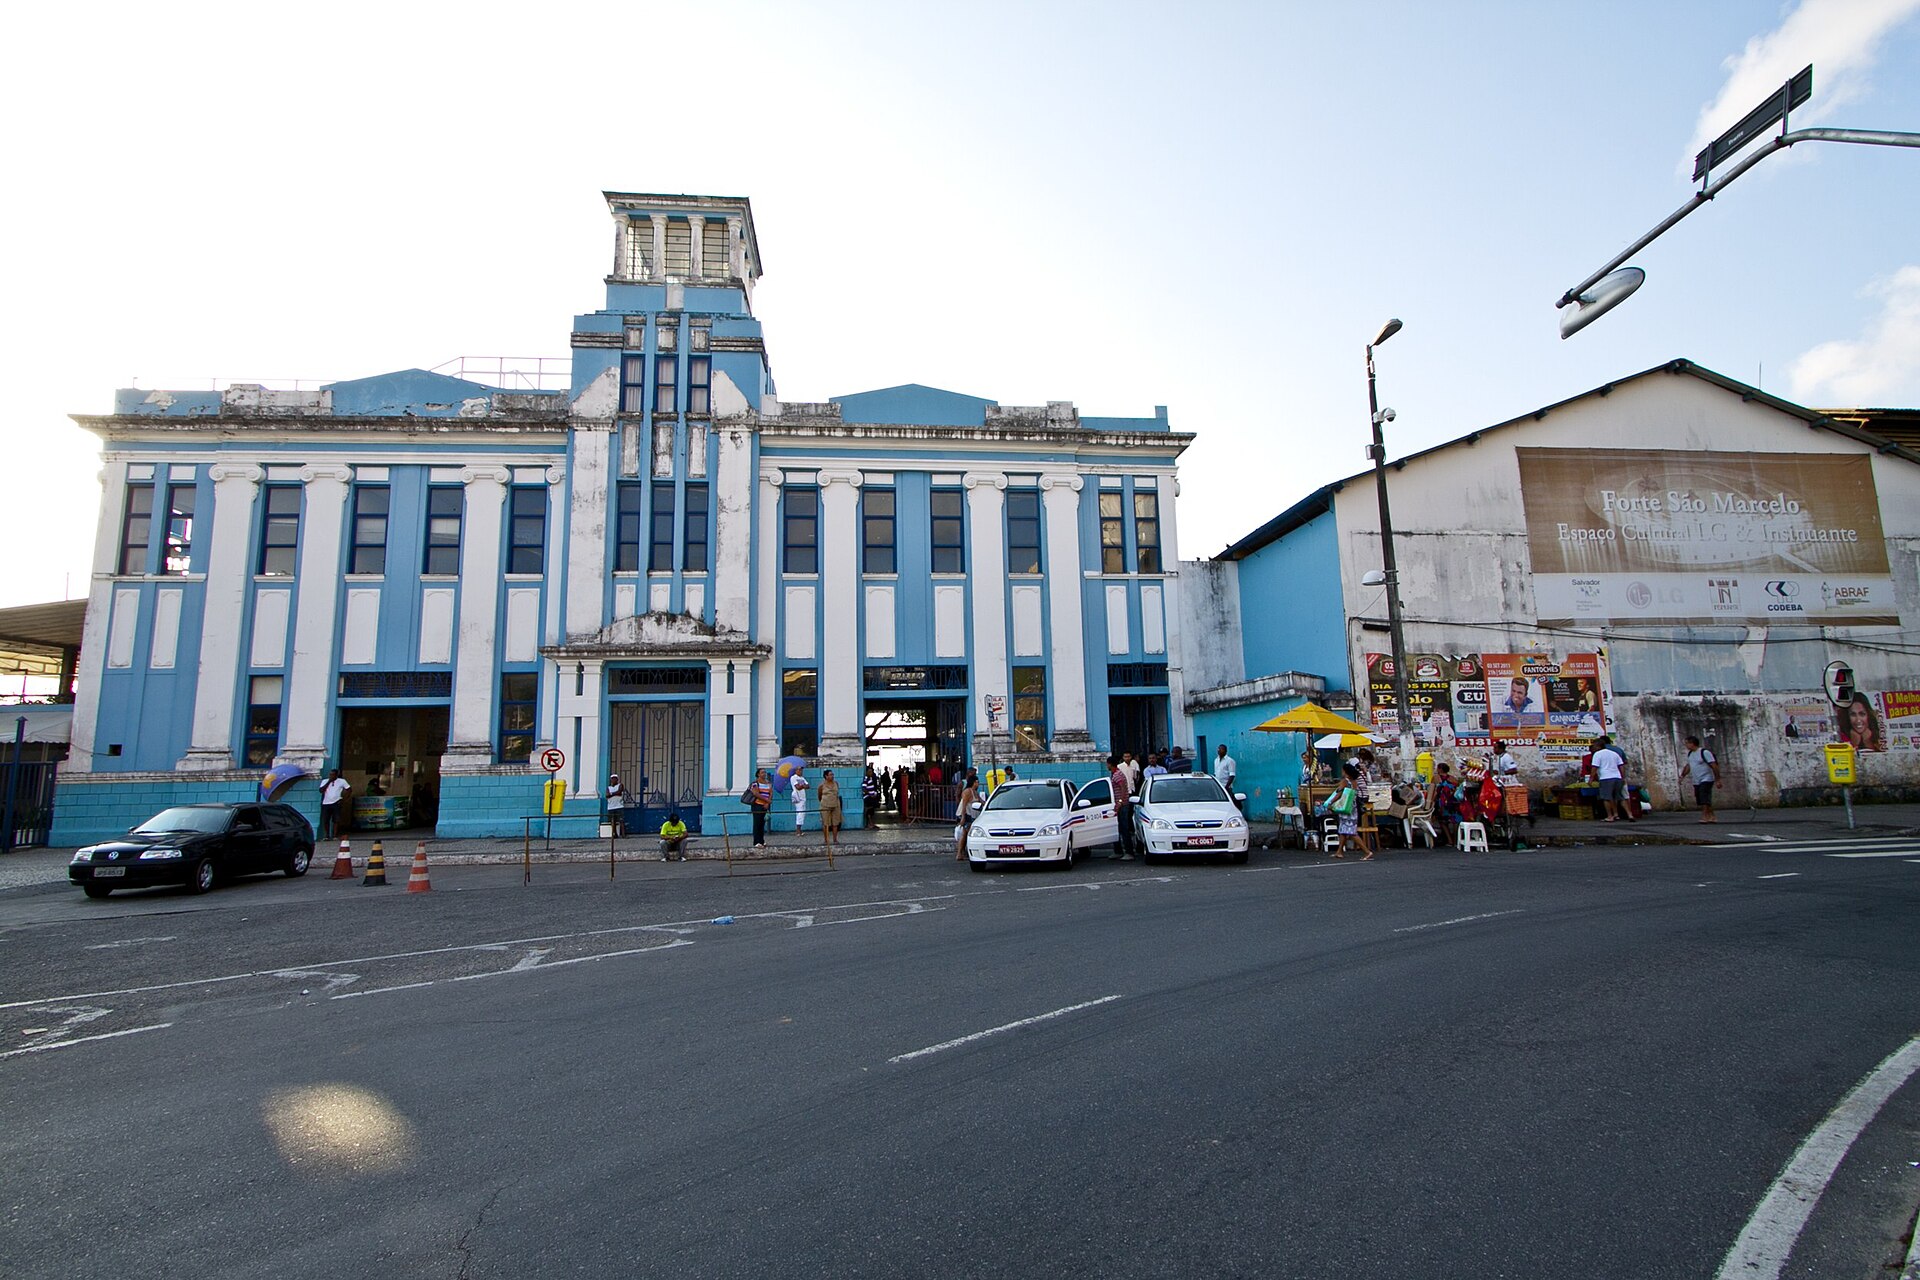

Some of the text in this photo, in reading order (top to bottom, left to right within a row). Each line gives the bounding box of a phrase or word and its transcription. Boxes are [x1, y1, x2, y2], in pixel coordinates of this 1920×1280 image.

[1601, 490, 1800, 515] Forte São Marcelo
[1557, 523, 1616, 545] Espaço
[1621, 523, 1690, 541] Cultural
[1698, 523, 1727, 542] LG
[1762, 524, 1857, 542] Insinuante
[1834, 587, 1869, 598] ABRAF
[1767, 604, 1803, 612] CODEBA
[1523, 666, 1559, 674] FANTOCHES
[1889, 706, 1909, 719] para
